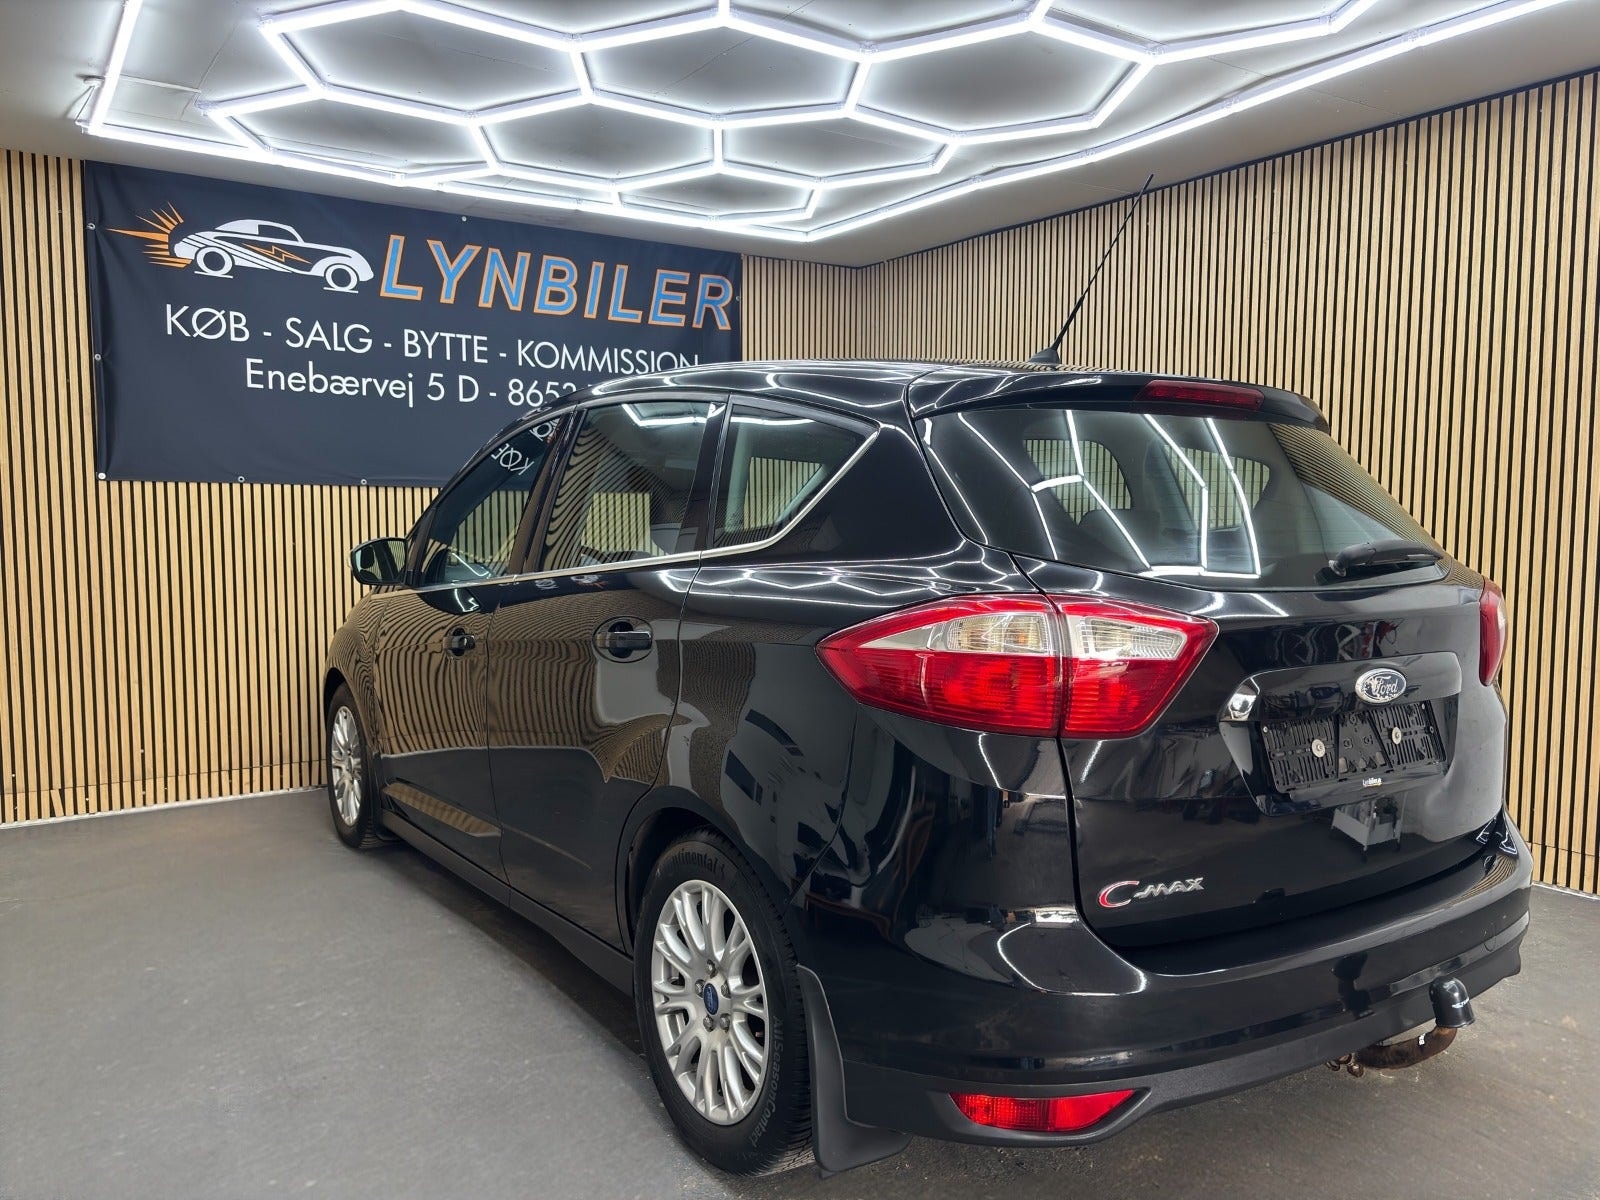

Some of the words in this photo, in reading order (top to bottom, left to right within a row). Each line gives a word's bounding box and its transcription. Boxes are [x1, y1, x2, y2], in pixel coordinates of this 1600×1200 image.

[379, 234, 733, 331] LYNBILER
[166, 303, 250, 342] KØB
[285, 316, 373, 354] SALG
[403, 328, 489, 364] BYTTE
[246, 357, 414, 408] Enebærvej
[426, 372, 445, 401] 5
[458, 374, 480, 403] D
